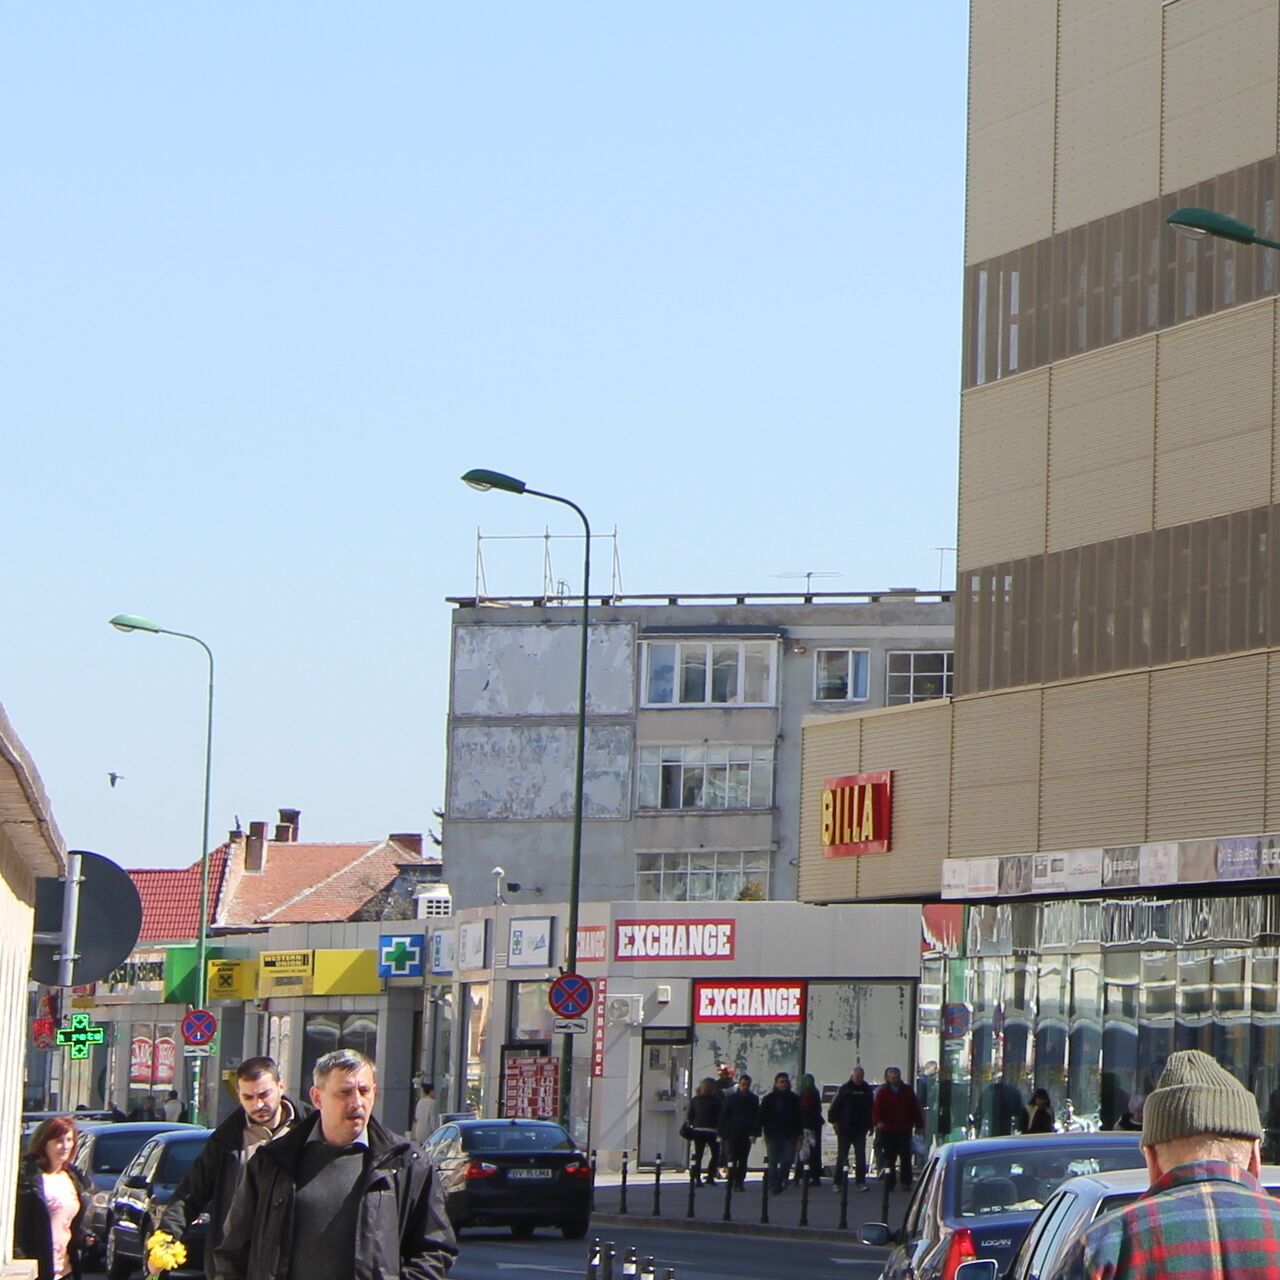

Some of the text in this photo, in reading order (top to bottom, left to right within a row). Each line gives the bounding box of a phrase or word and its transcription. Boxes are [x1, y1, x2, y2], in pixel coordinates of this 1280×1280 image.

[821, 783, 874, 847] BILLA
[617, 923, 732, 957] EXCHANGE
[699, 987, 801, 1016] EXCHANGE
[595, 981, 606, 1076] EXCHANGE
[981, 1238, 1012, 1247] LOGAN
